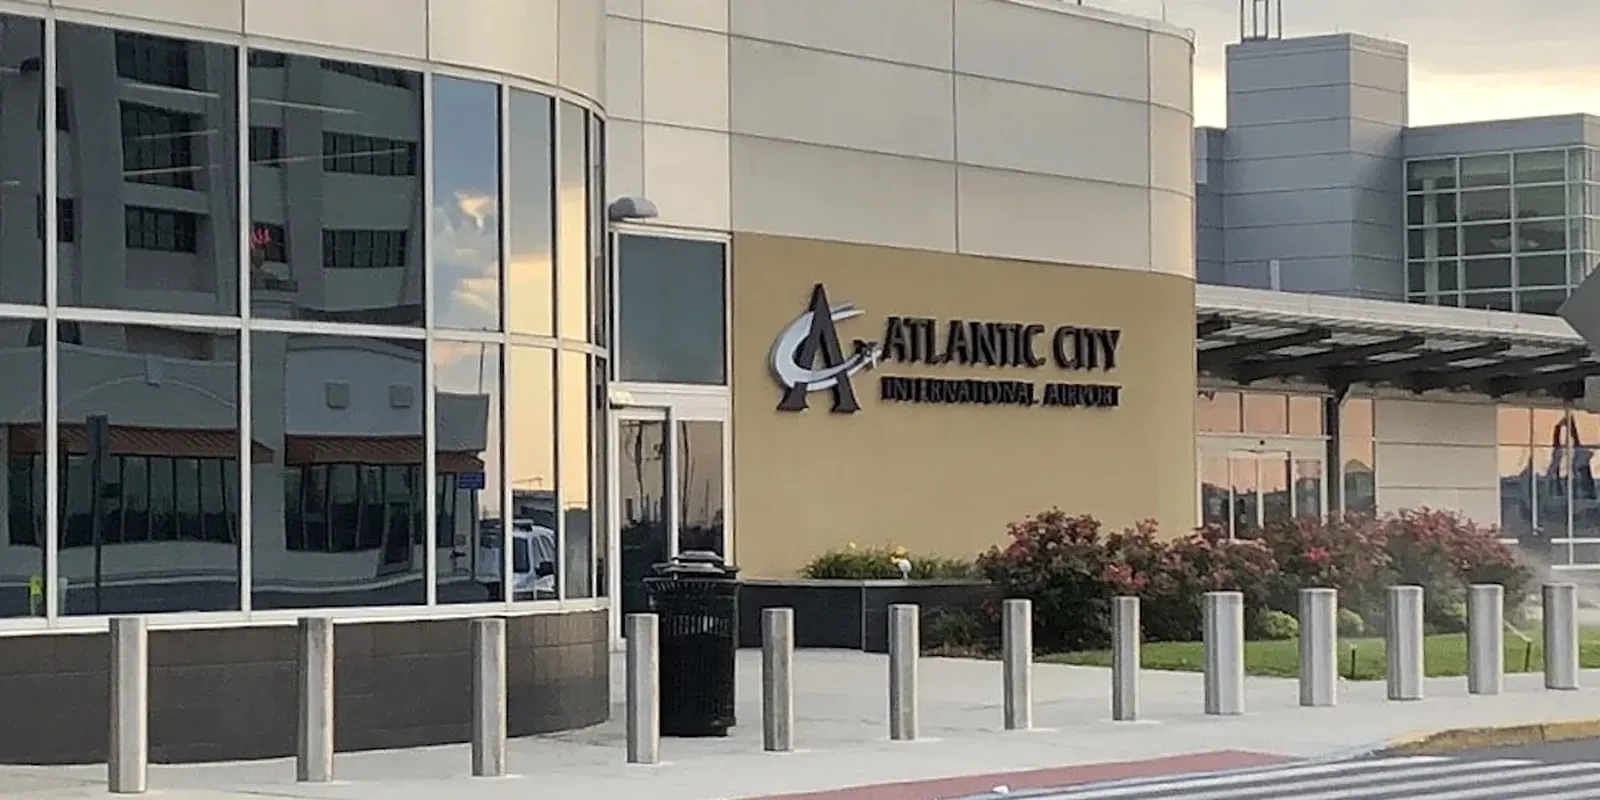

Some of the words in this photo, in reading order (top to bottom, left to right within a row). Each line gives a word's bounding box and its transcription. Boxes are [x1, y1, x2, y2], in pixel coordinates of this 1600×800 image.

[881, 316, 1046, 367] ATLANTIC
[1053, 326, 1121, 370] CITY
[880, 375, 1039, 406] INTERNATIONAL
[1041, 383, 1122, 407] AIRPORT
